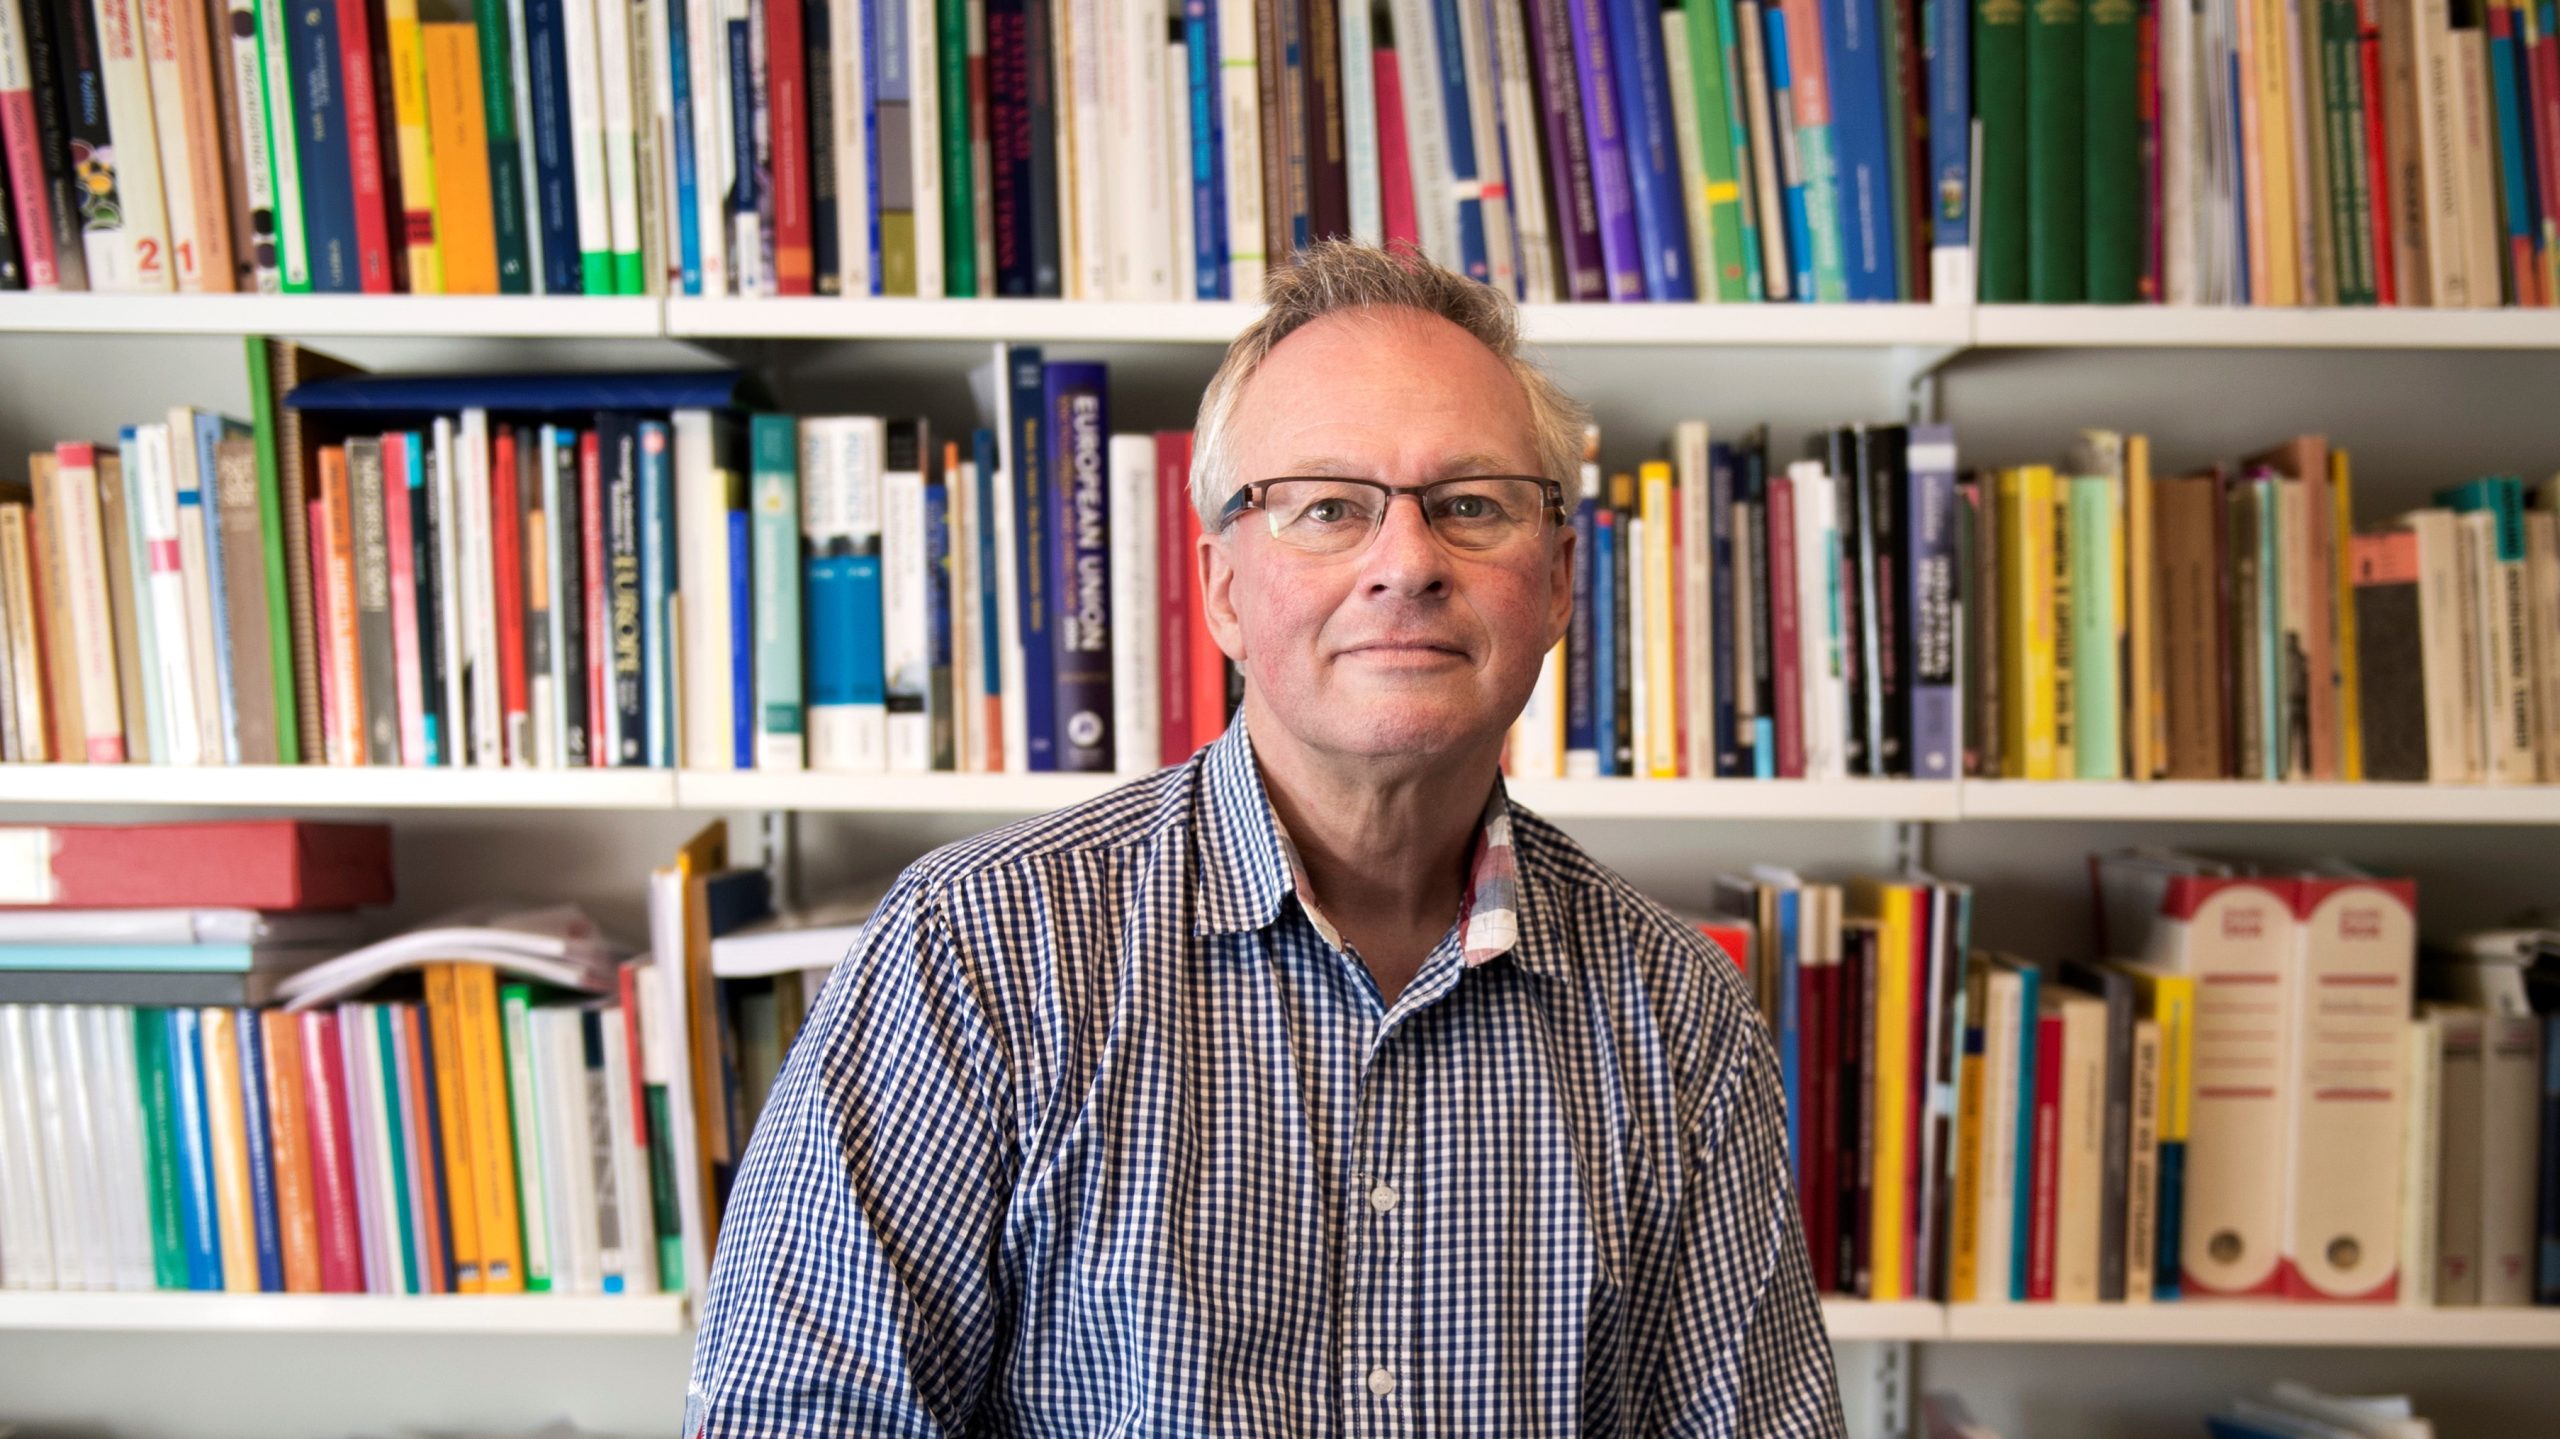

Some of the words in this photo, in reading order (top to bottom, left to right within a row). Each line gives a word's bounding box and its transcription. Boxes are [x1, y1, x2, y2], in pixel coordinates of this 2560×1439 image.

[137, 239, 160, 271] 2
[176, 241, 194, 273] 1
[1073, 395, 1104, 549] EUROPEAN
[613, 556, 641, 676] EUROPE
[1078, 555, 1106, 652] UNION
[1916, 558, 1934, 677] RELATIONS
[1932, 555, 1951, 677] INDUSTRIAL
